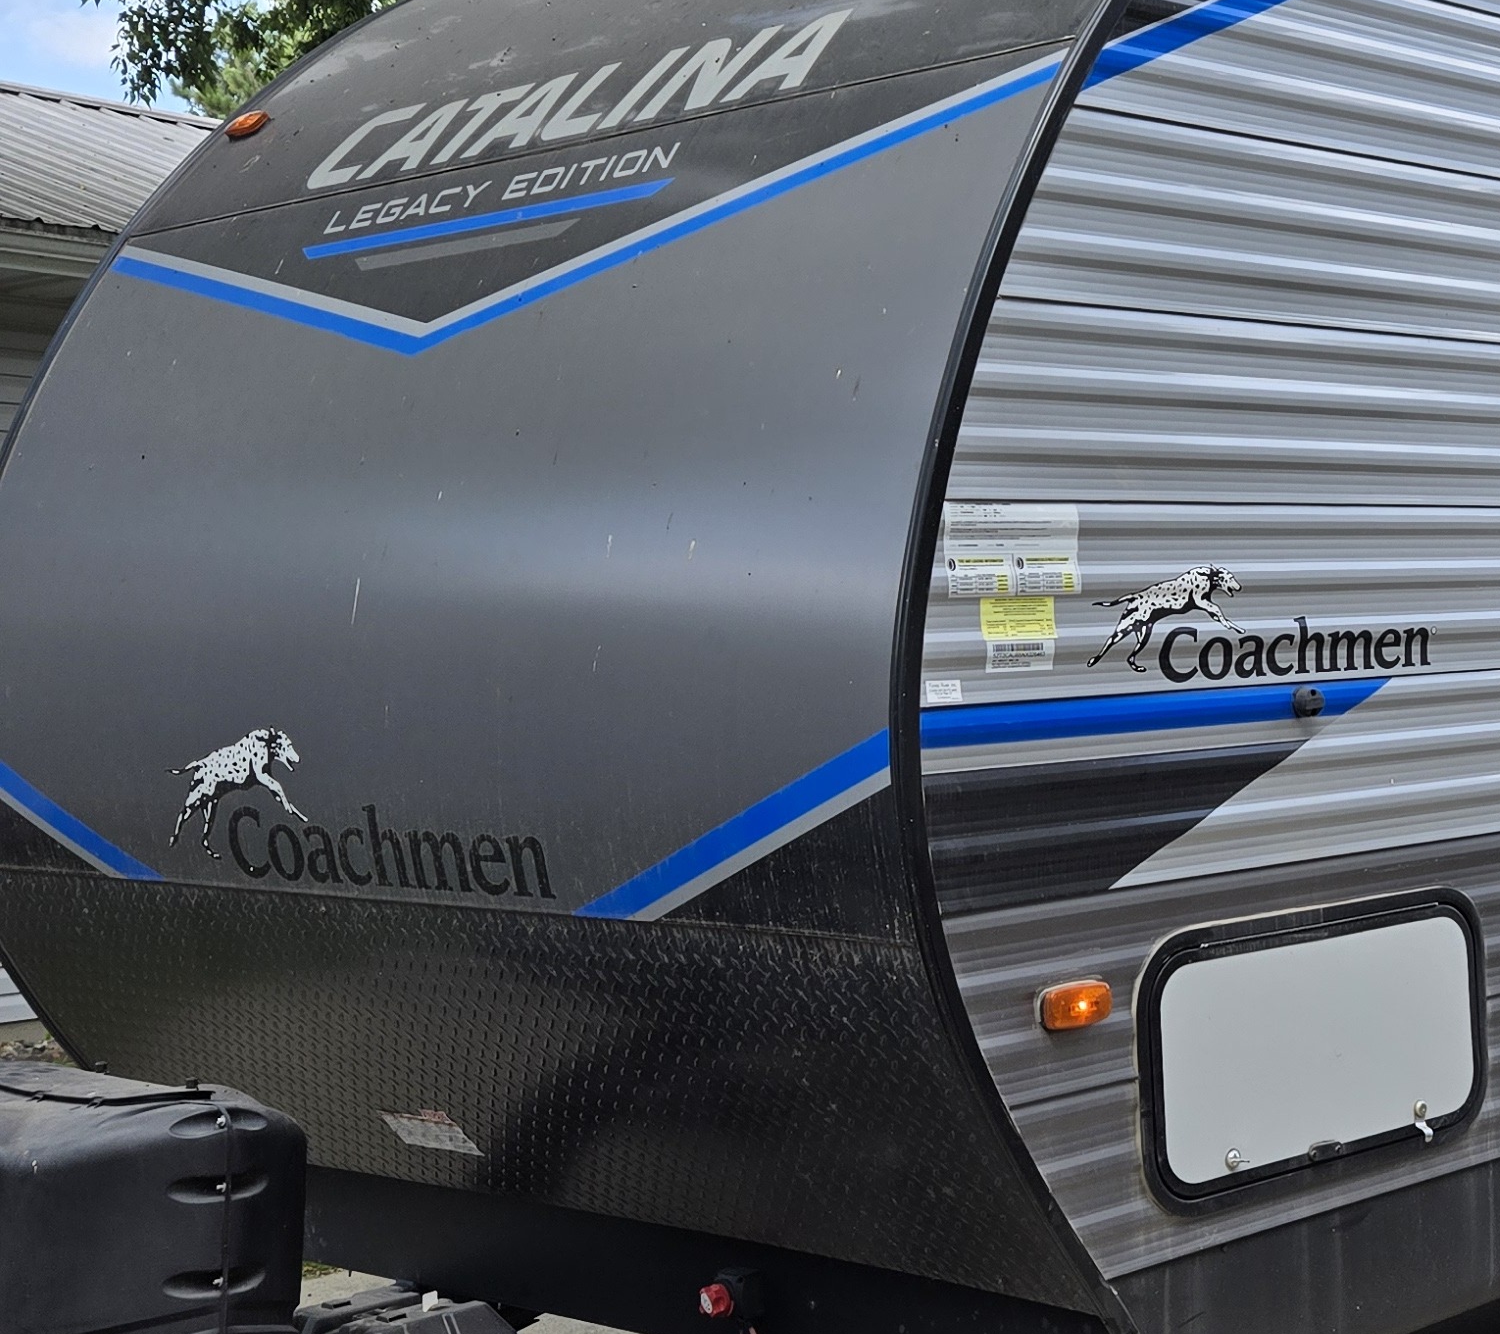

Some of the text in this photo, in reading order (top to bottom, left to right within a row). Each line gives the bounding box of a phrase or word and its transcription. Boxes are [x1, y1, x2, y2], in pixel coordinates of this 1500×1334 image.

[306, 7, 855, 191] CATALINA
[323, 142, 681, 235] LEGACY EDITION
[1158, 615, 1432, 684] Coachmen
[228, 804, 557, 900] Coachmen
